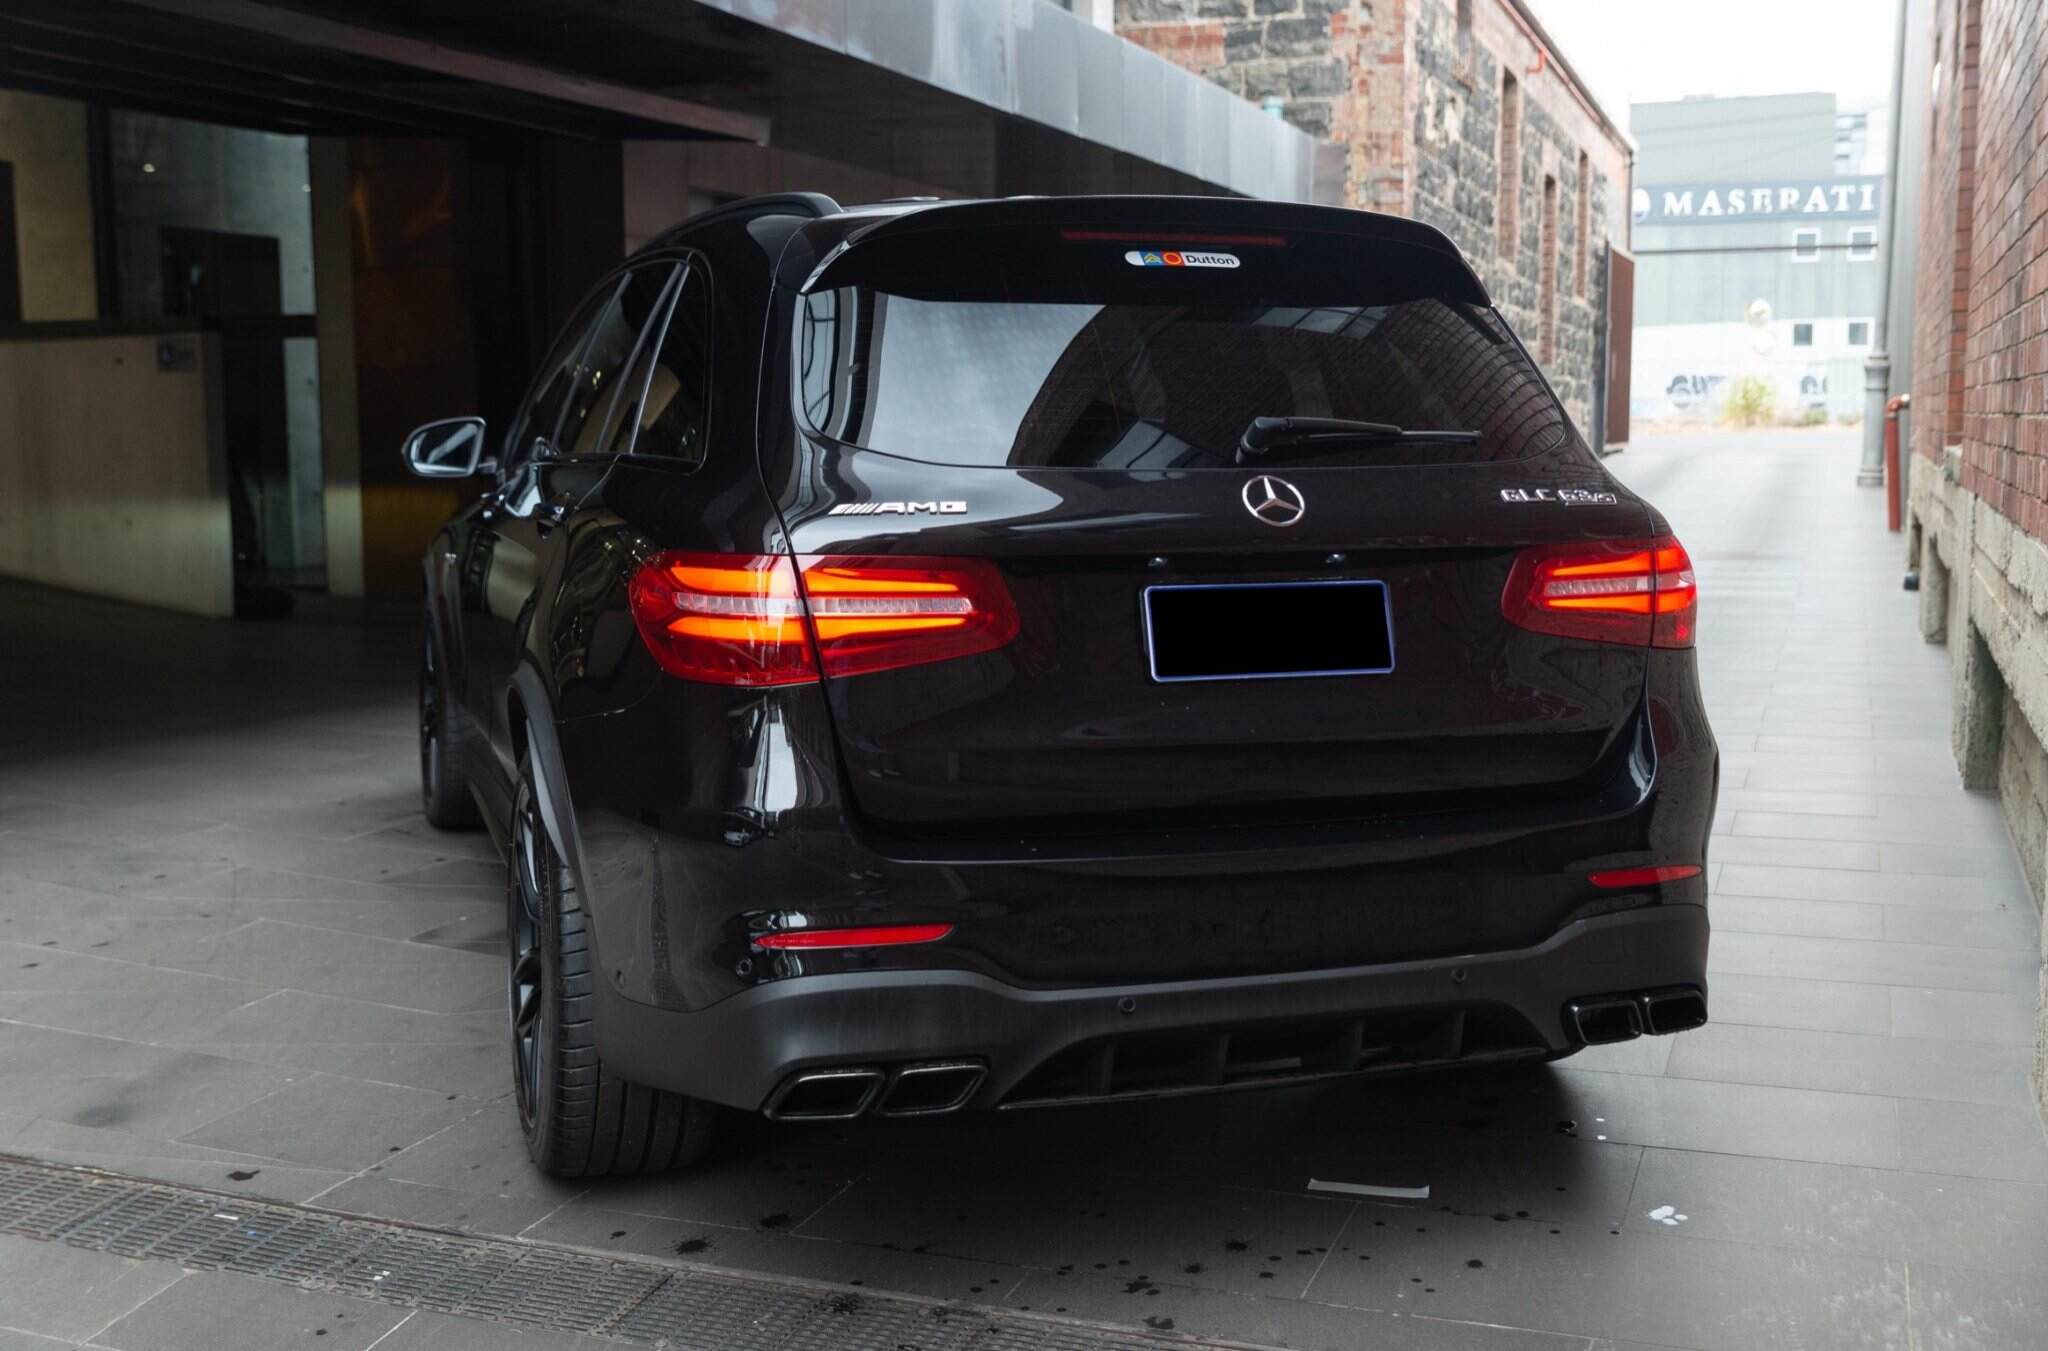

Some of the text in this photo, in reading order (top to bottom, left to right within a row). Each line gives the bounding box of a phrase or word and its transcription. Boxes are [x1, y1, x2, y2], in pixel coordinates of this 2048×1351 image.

[1664, 184, 1875, 216] MASERATI
[1185, 254, 1235, 265] Dutton
[1501, 489, 1556, 502] GLC
[872, 501, 967, 515] AMG
